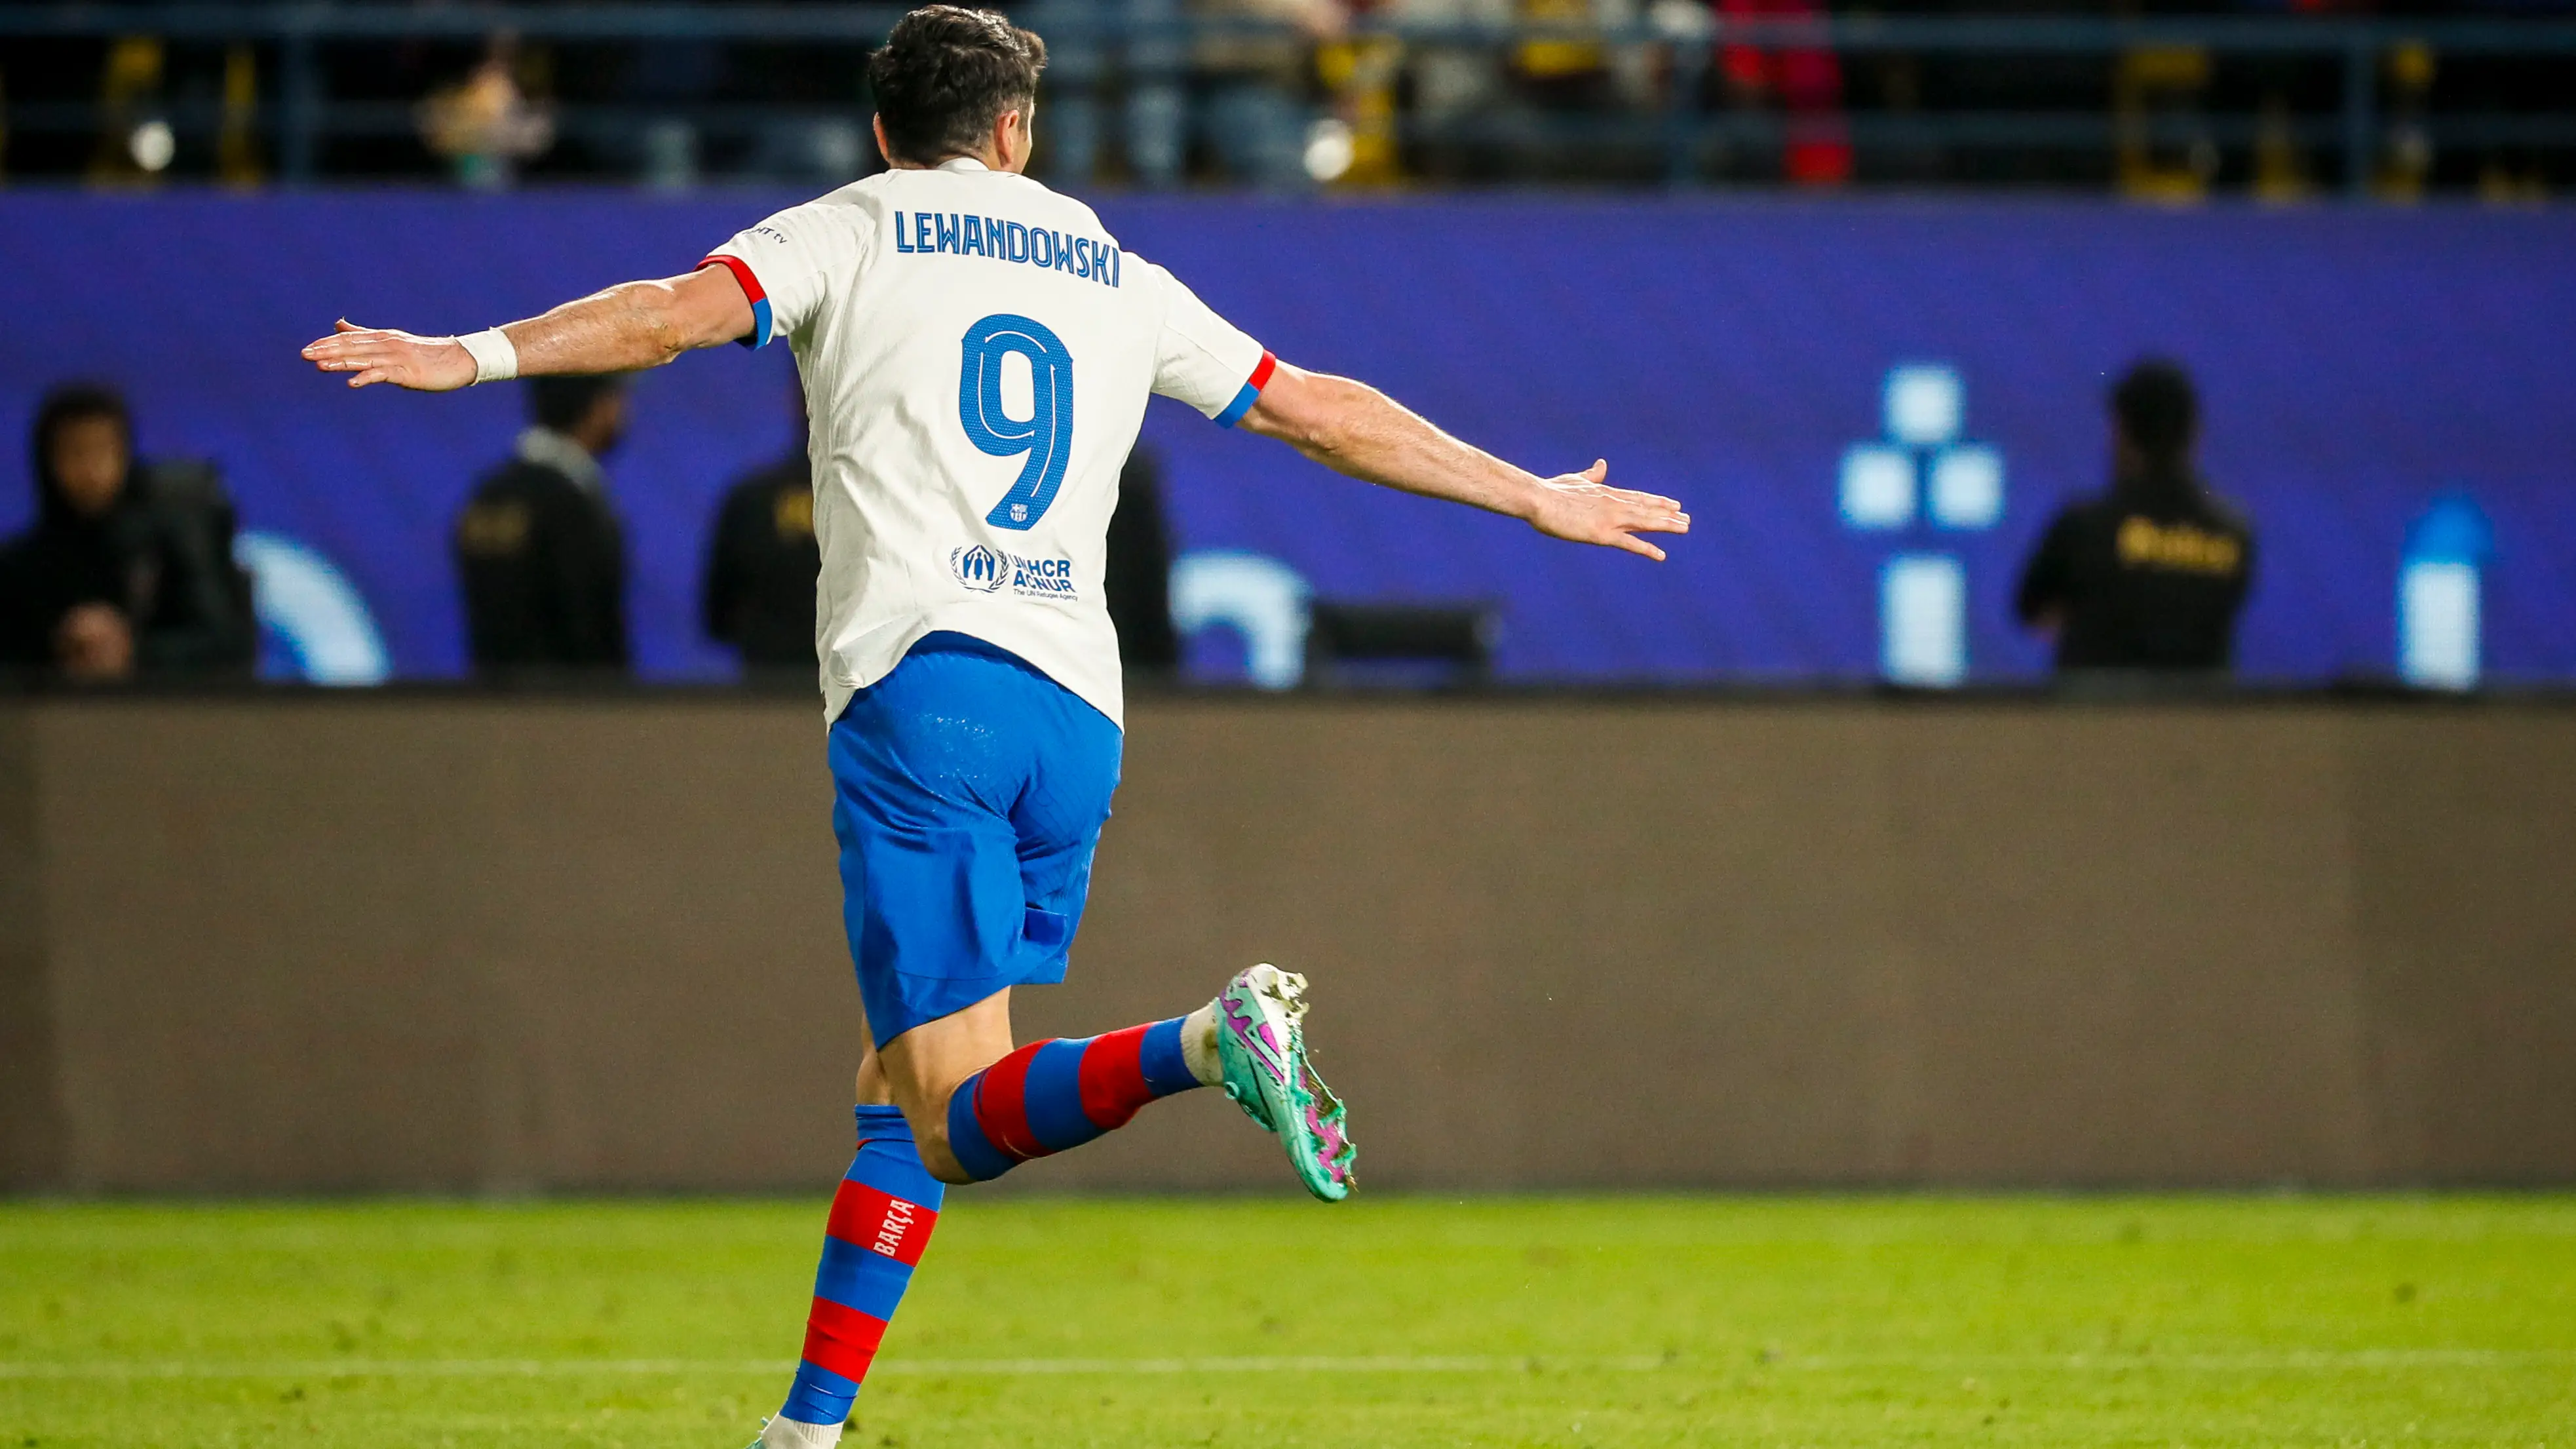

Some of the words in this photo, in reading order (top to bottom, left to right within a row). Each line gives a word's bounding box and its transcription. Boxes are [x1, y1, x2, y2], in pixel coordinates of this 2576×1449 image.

[773, 233, 788, 244] tv
[895, 210, 1120, 288] LEWANDOWSKI
[959, 314, 1073, 531] 9
[1013, 570, 1076, 592] ACNUR
[873, 1199, 915, 1257] BARÇA
